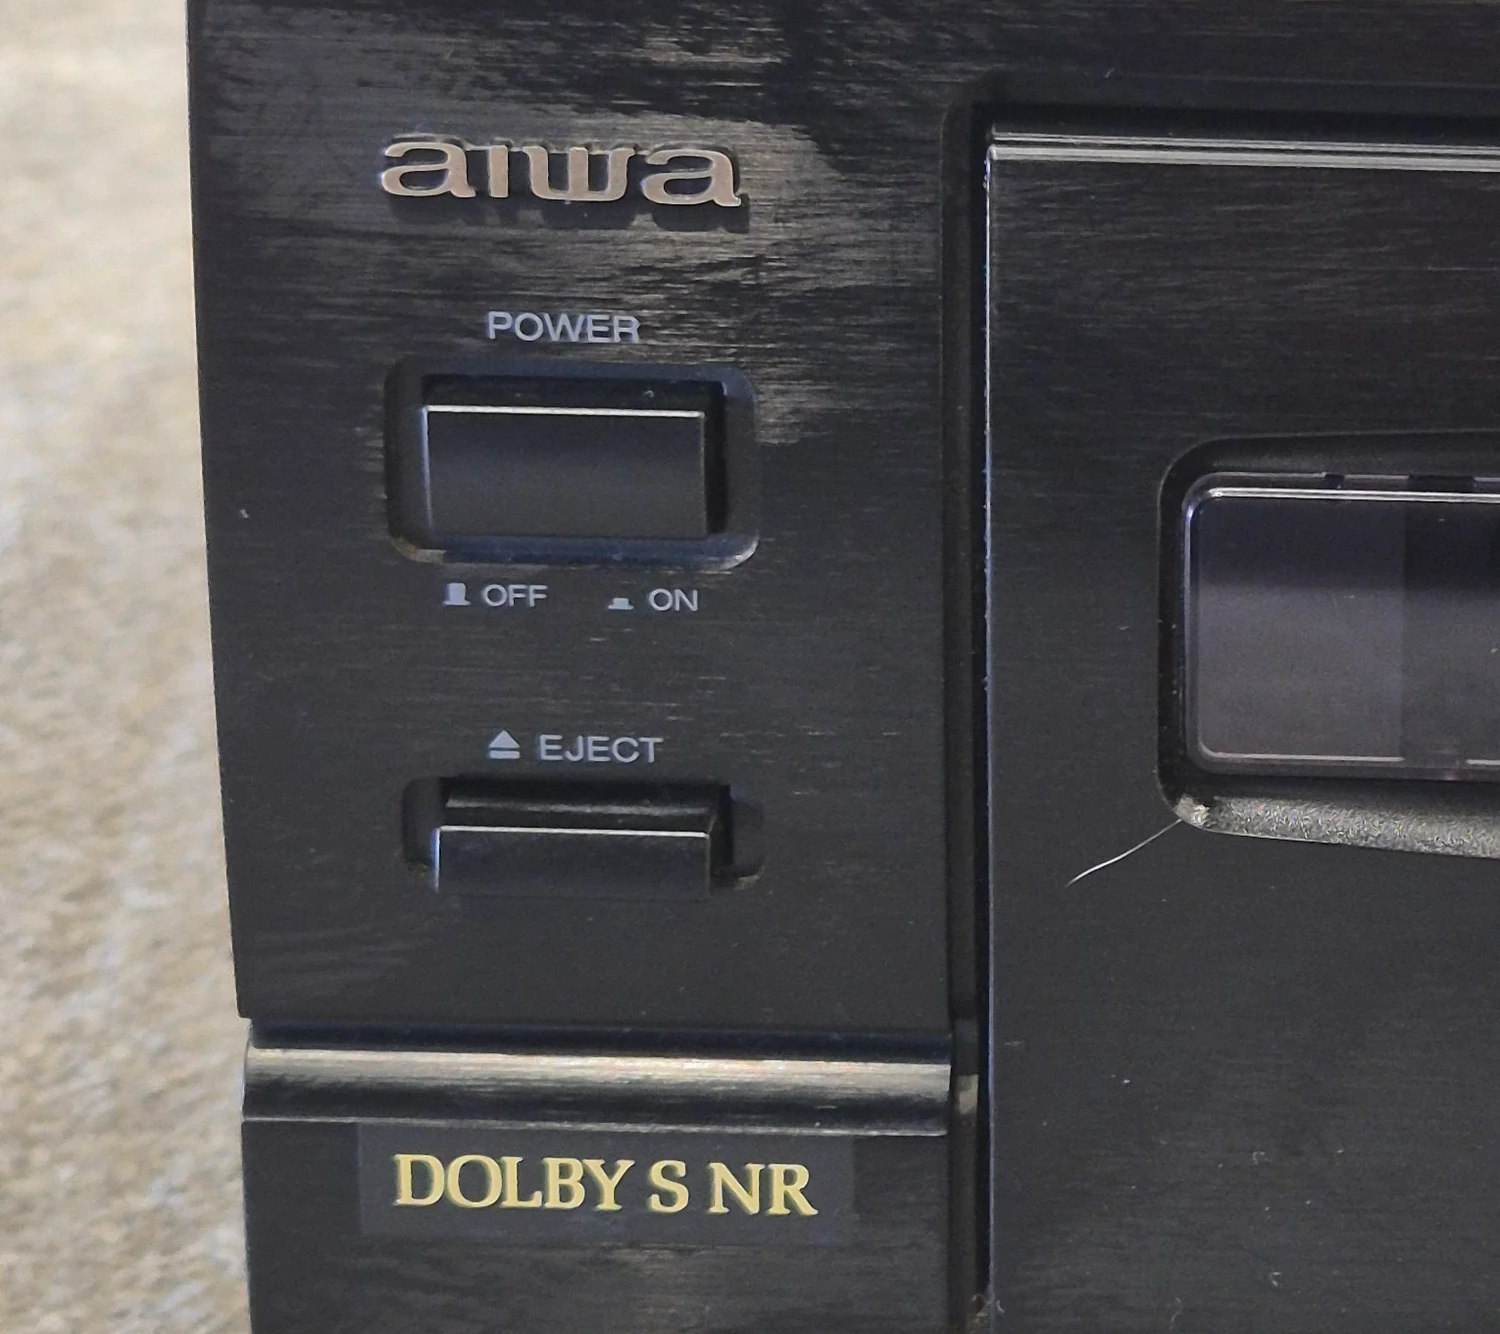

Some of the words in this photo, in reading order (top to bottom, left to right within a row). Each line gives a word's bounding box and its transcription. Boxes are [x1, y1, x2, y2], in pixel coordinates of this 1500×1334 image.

[380, 132, 743, 208] aiwa
[487, 309, 641, 345] POWER
[482, 583, 549, 609] OFF
[647, 586, 699, 612] ON
[538, 733, 663, 764] EJECT
[393, 1153, 635, 1212] DOLBY
[648, 1159, 690, 1213] S
[708, 1162, 819, 1216] NR
